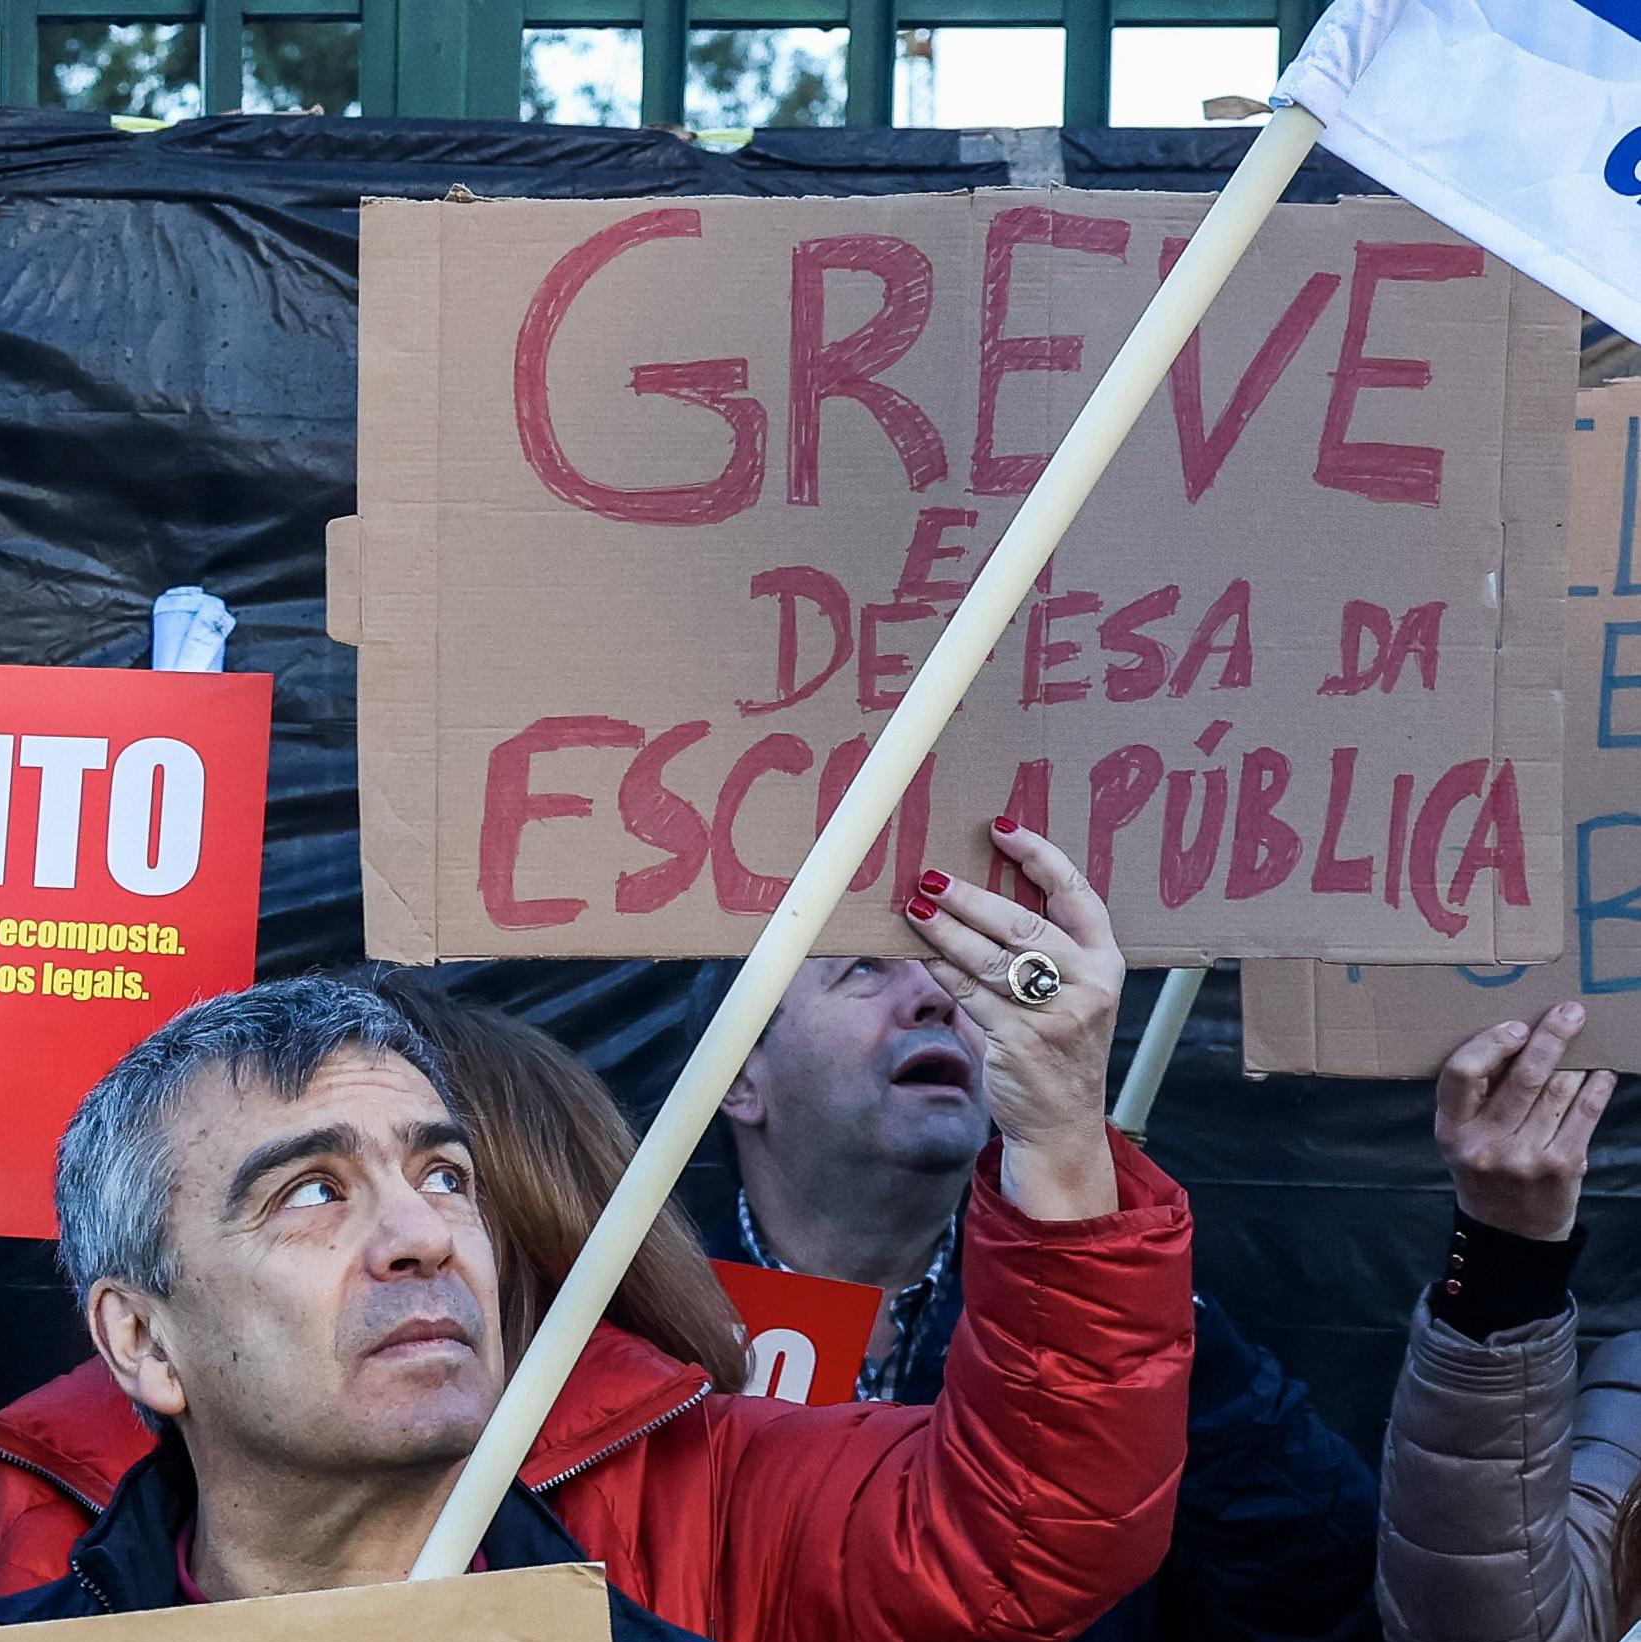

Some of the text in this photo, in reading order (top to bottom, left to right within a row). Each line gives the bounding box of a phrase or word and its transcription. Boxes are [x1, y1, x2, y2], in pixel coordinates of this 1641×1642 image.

[513, 207, 1485, 528] GREVE
[894, 507, 1055, 605] E
[734, 565, 1255, 719] DEESA
[1317, 600, 1448, 697] DA
[1085, 720, 1532, 939] PÚBLICA
[41, 961, 151, 1002] legais.
